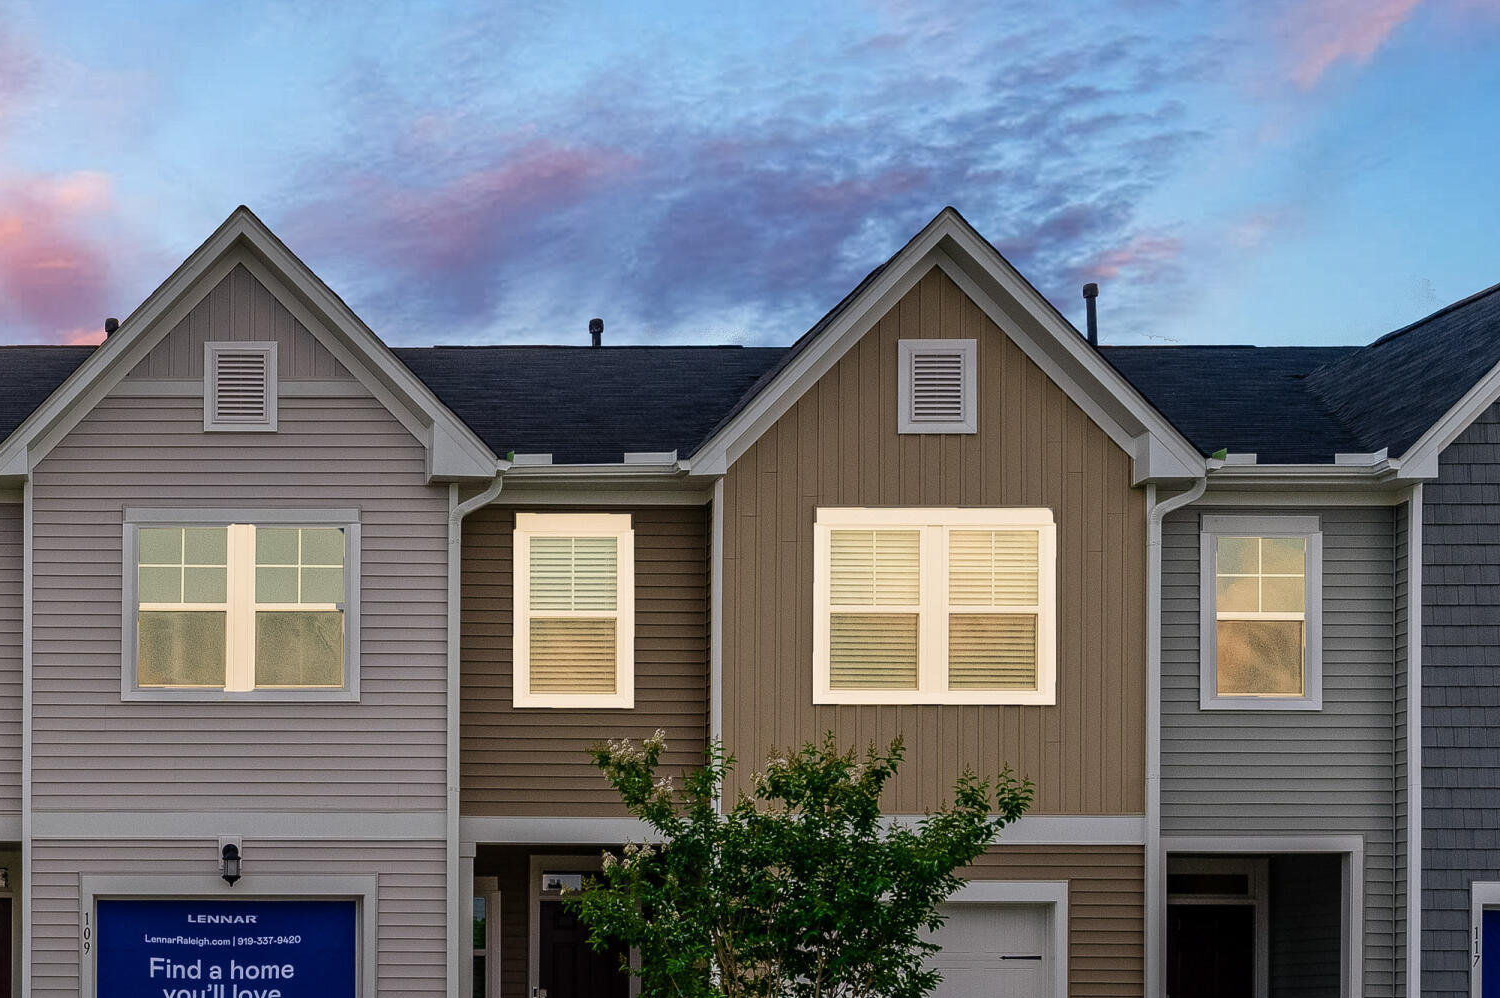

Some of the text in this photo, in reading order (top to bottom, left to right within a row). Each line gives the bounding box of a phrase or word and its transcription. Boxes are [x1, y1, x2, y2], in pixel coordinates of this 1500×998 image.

[187, 914, 257, 924] LENNAR
[144, 934, 231, 946] LennarRaleigh.com
[237, 935, 302, 946] 919-337-9420
[1473, 926, 1481, 968] 117
[150, 957, 294, 980] Find a home
